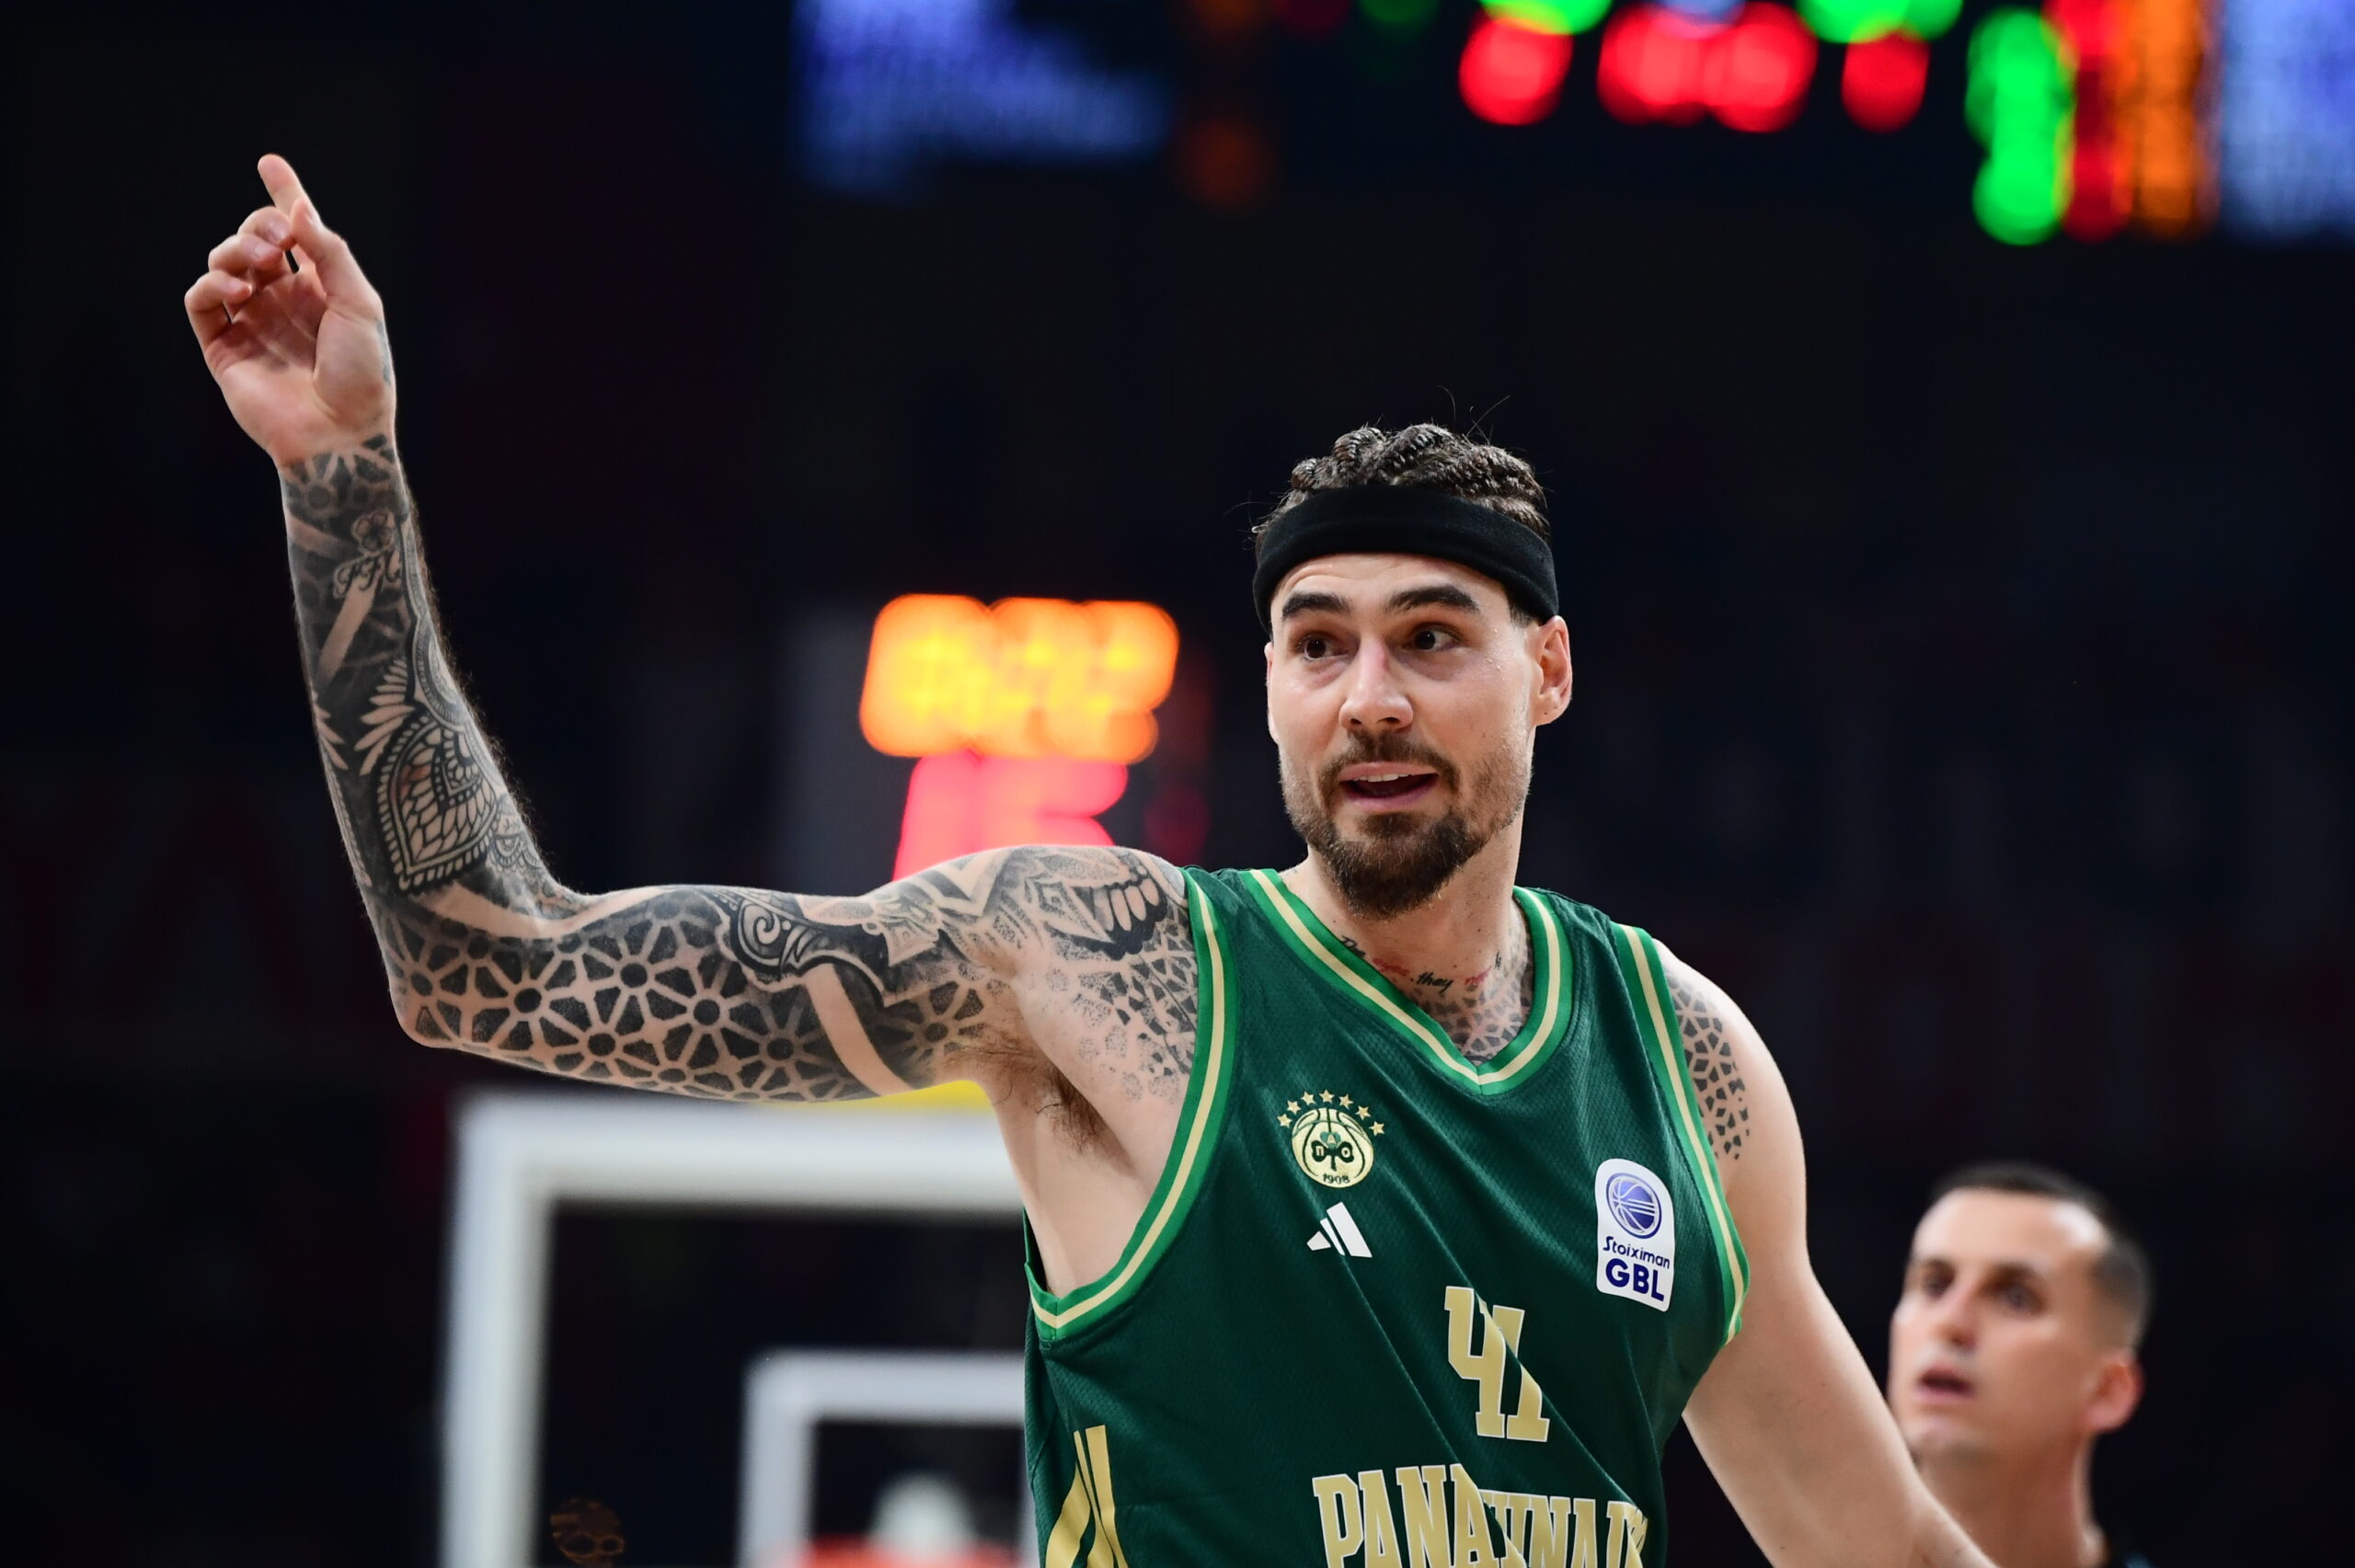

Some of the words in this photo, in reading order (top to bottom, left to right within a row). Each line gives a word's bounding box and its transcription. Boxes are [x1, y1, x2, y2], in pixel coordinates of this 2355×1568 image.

[1322, 1173, 1350, 1185] 1908
[1603, 1236, 1671, 1269] Stoiximan
[1605, 1257, 1665, 1302] GBL
[1443, 1285, 1550, 1443] 41
